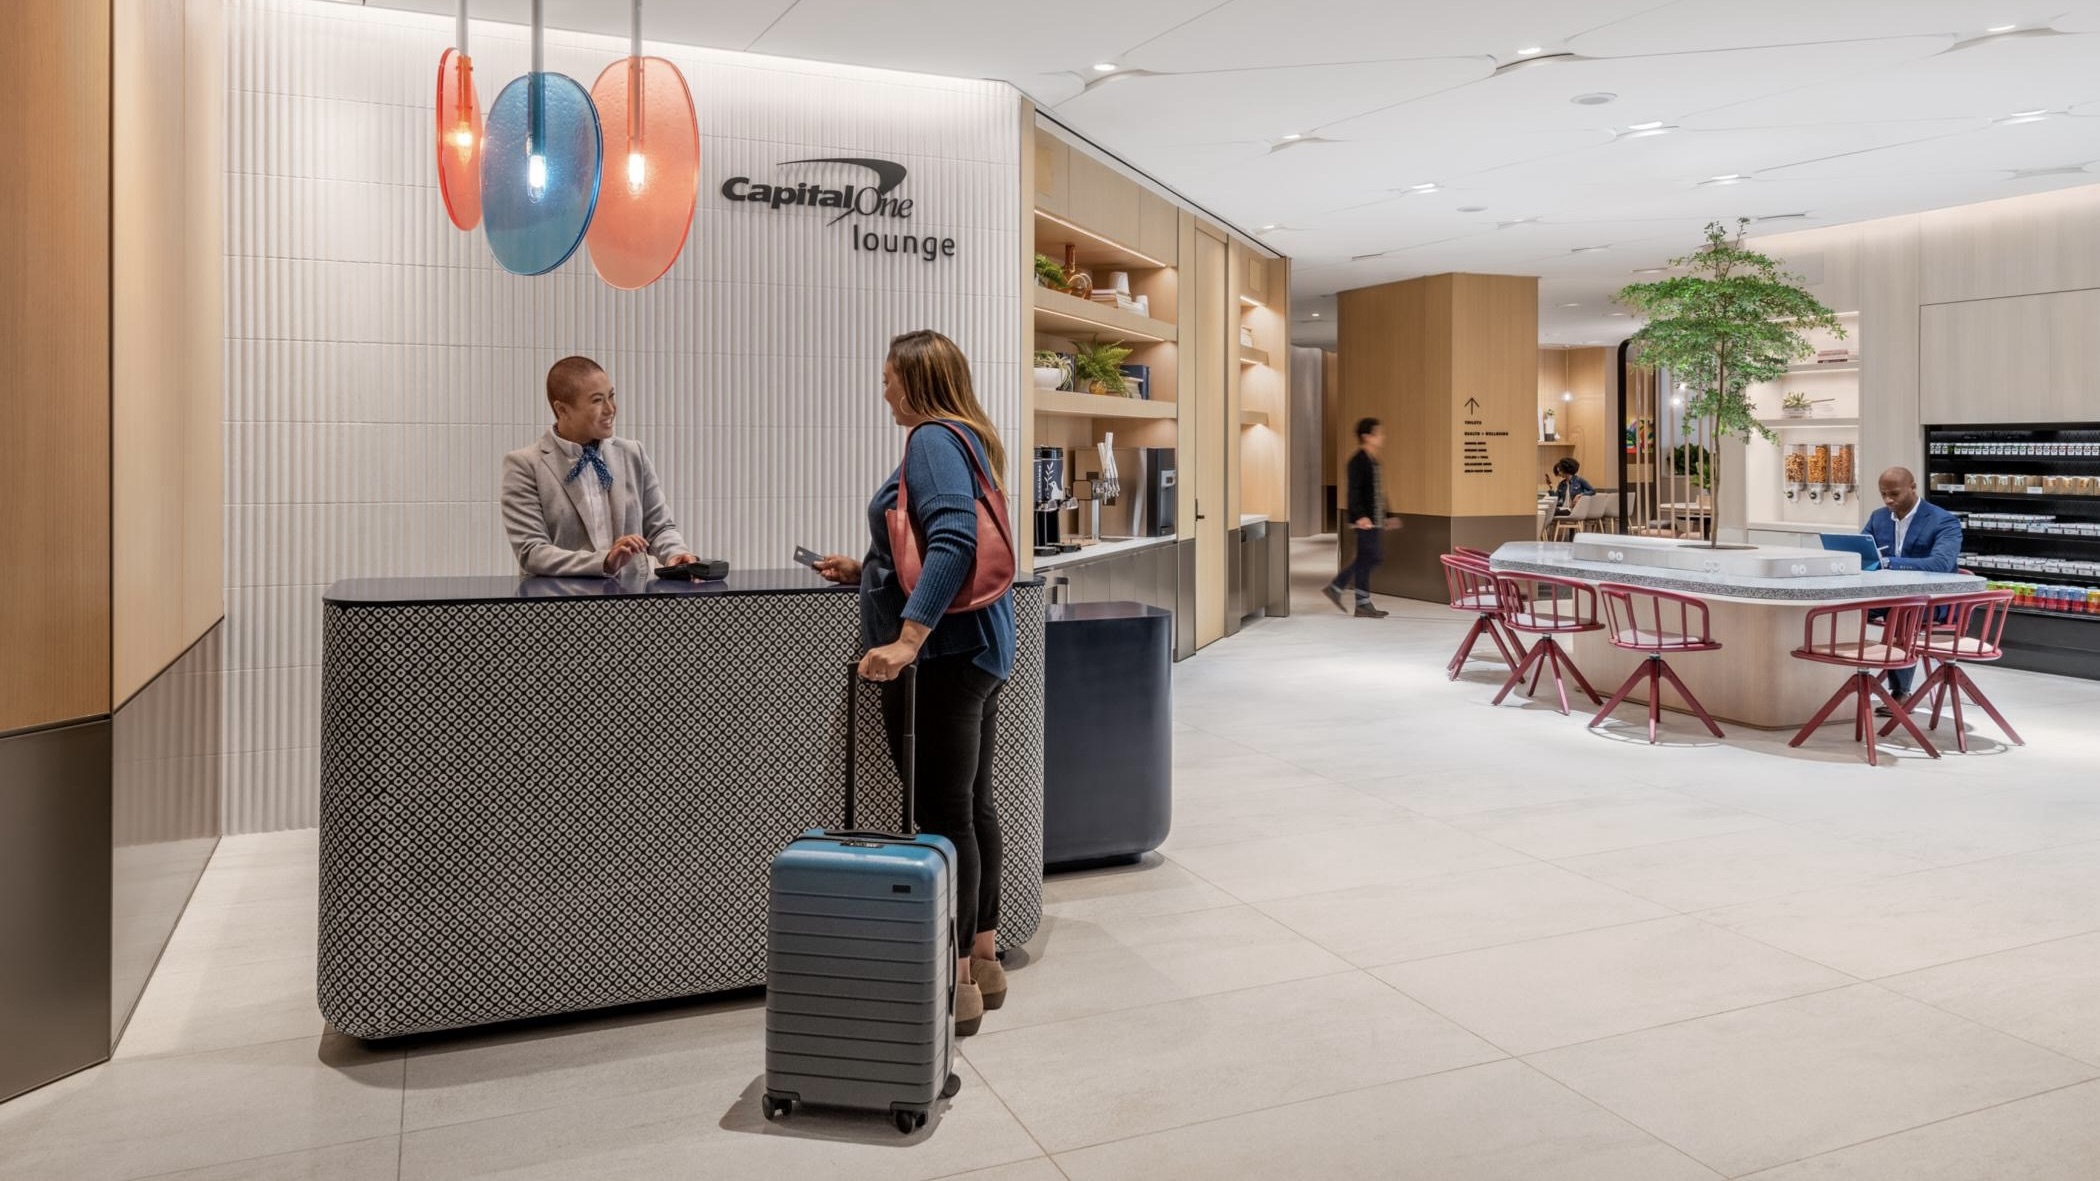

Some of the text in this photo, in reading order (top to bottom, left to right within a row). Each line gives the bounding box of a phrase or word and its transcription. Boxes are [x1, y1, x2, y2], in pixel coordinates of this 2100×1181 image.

[722, 177, 914, 219] Capital One
[853, 224, 956, 262] lounge
